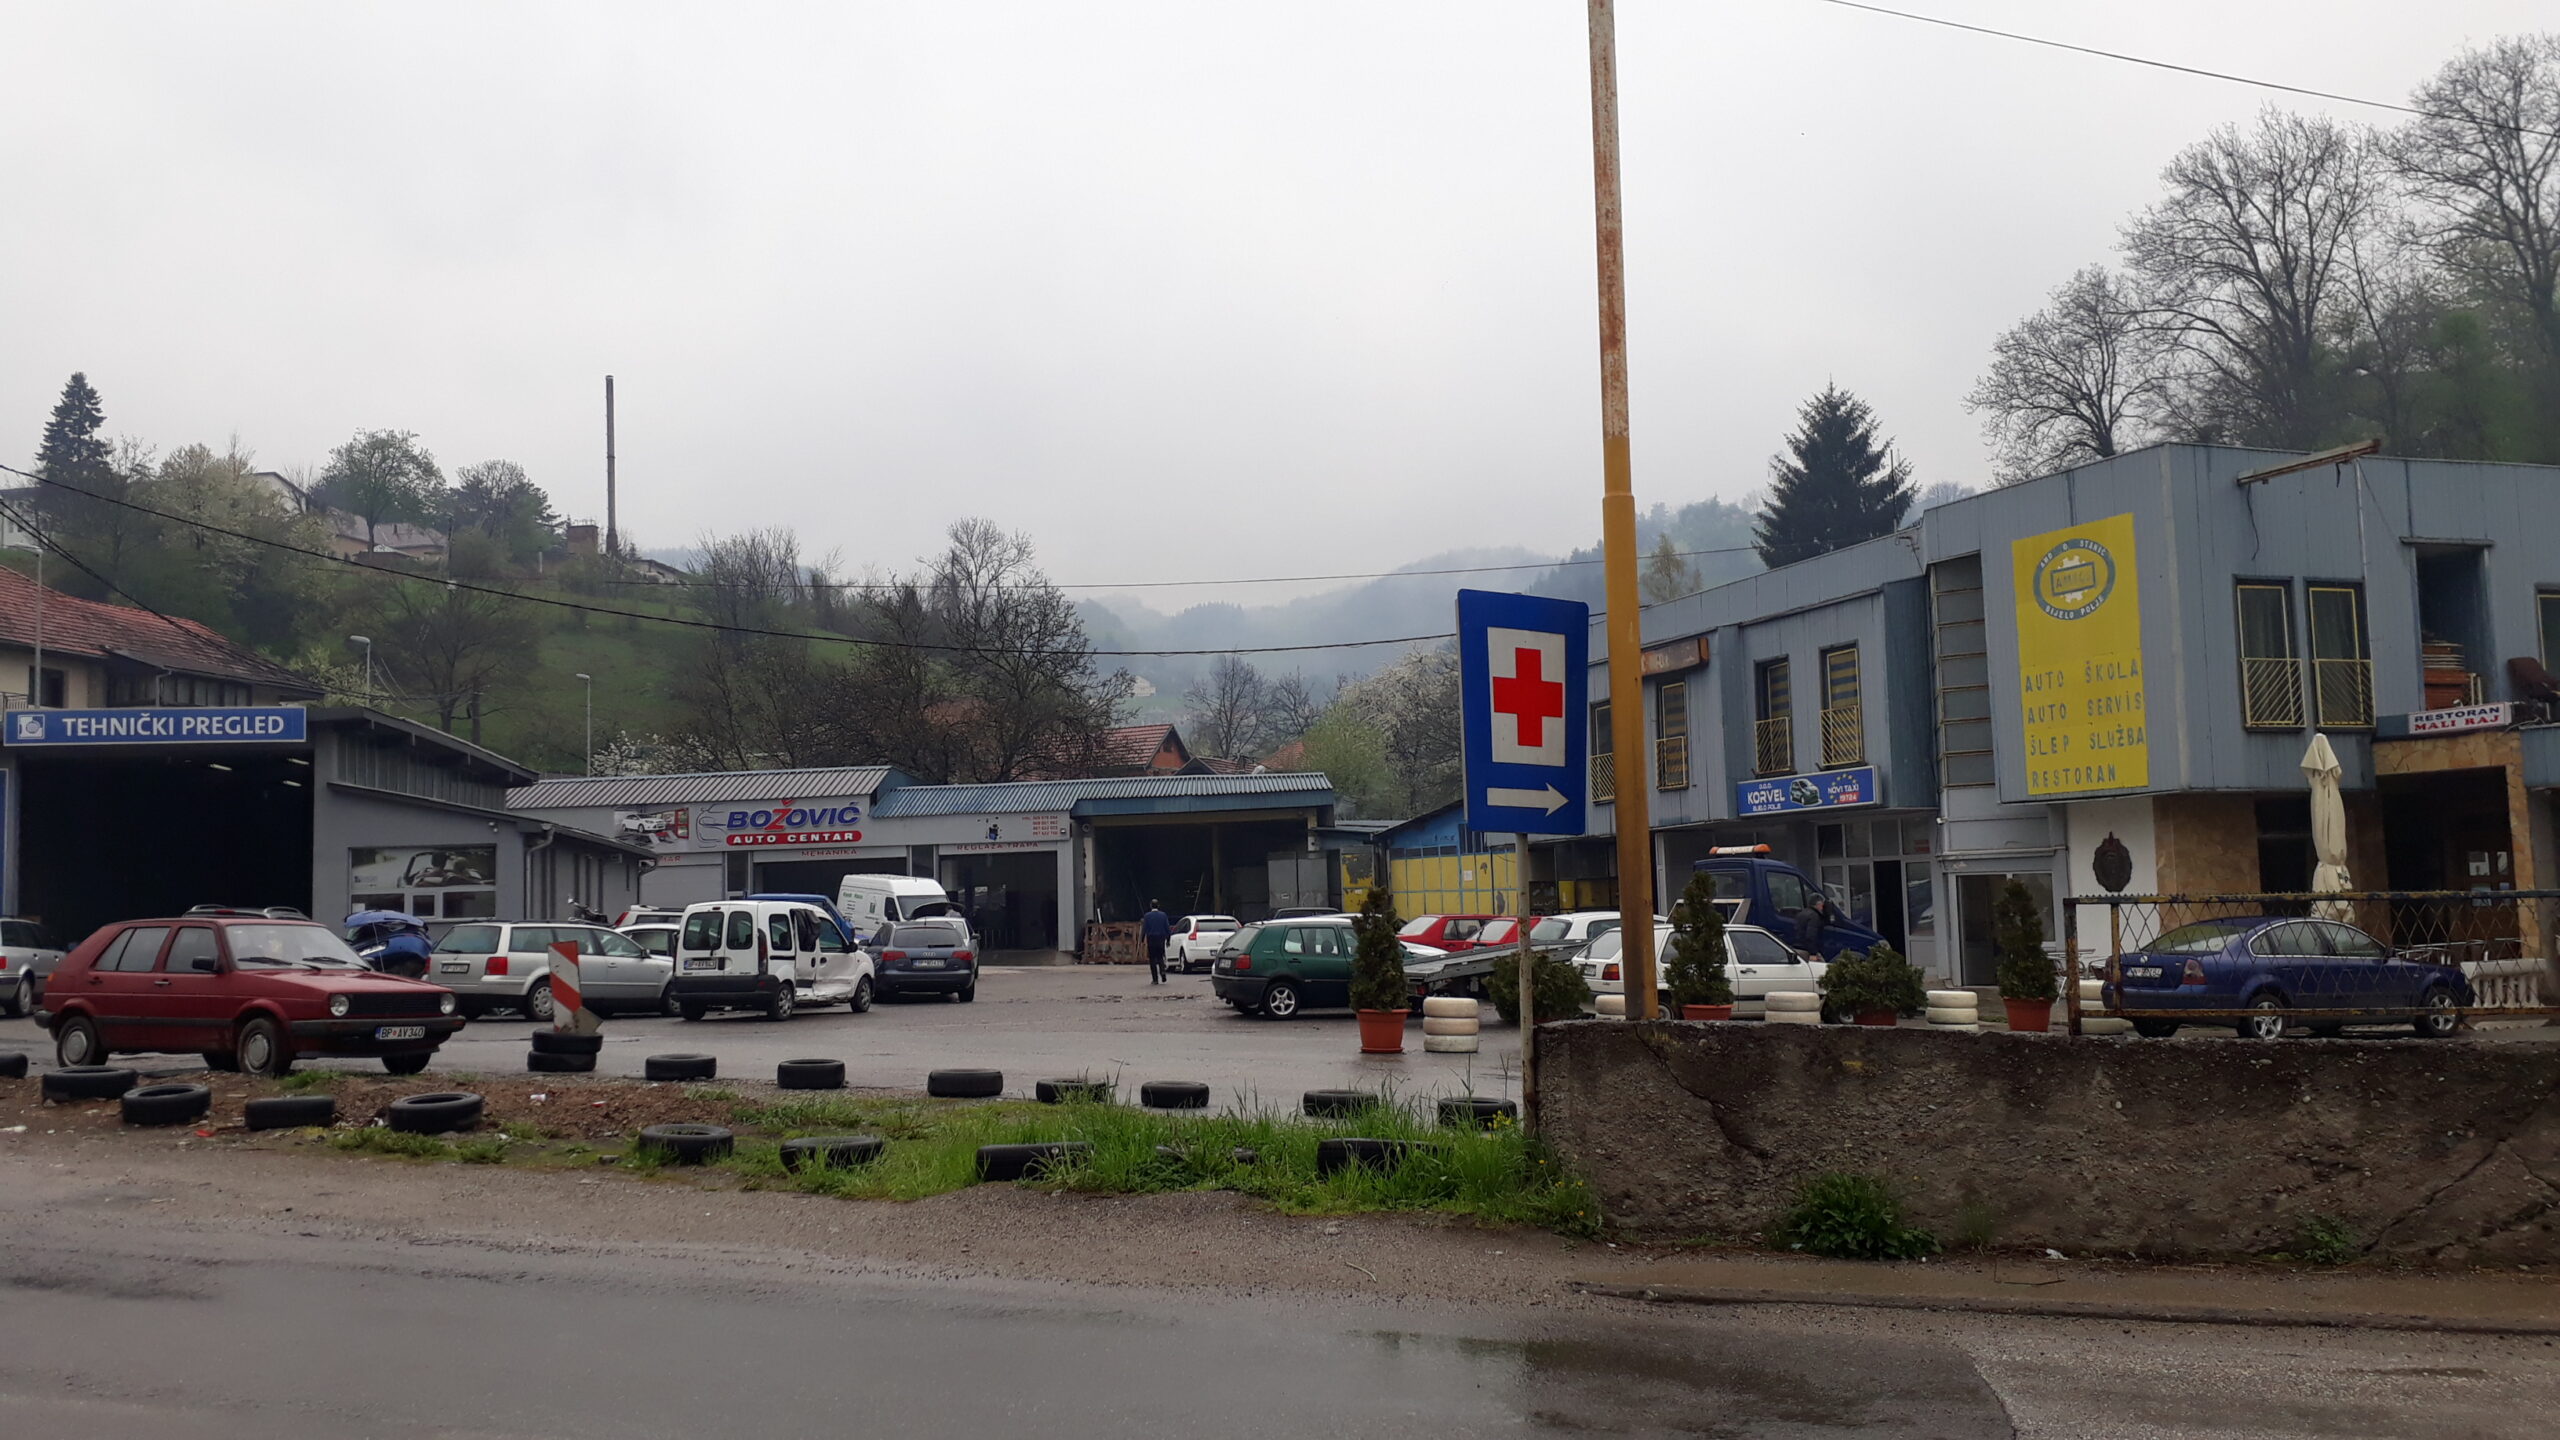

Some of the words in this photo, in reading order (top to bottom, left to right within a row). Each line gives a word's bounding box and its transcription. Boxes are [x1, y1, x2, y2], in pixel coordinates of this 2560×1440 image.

[2044, 604, 2075, 619] BIJELO
[2080, 595, 2105, 616] POLJE
[2025, 670, 2064, 693] AUTO
[2084, 658, 2139, 684] ŠKOLA
[62, 713, 174, 737] TEHNIČKI
[181, 716, 284, 735] PREGLED
[2027, 702, 2067, 725] AUTO
[2414, 706, 2499, 722] RESTORAN
[2414, 720, 2456, 731] MALI
[2465, 715, 2499, 725] RAJ
[2030, 734, 2070, 756] ŠLEP
[2089, 723, 2145, 751] SLUŽBA
[2031, 763, 2116, 789] RESTORAN
[1747, 788, 1786, 805] KORVEL
[1827, 786, 1843, 794] NOVI
[1844, 783, 1859, 792] TAXI
[726, 797, 861, 832] BOŽOVIĆ
[733, 835, 777, 844] AUTO
[787, 832, 854, 842] CENTAR
[801, 849, 857, 857] MEHANIKA
